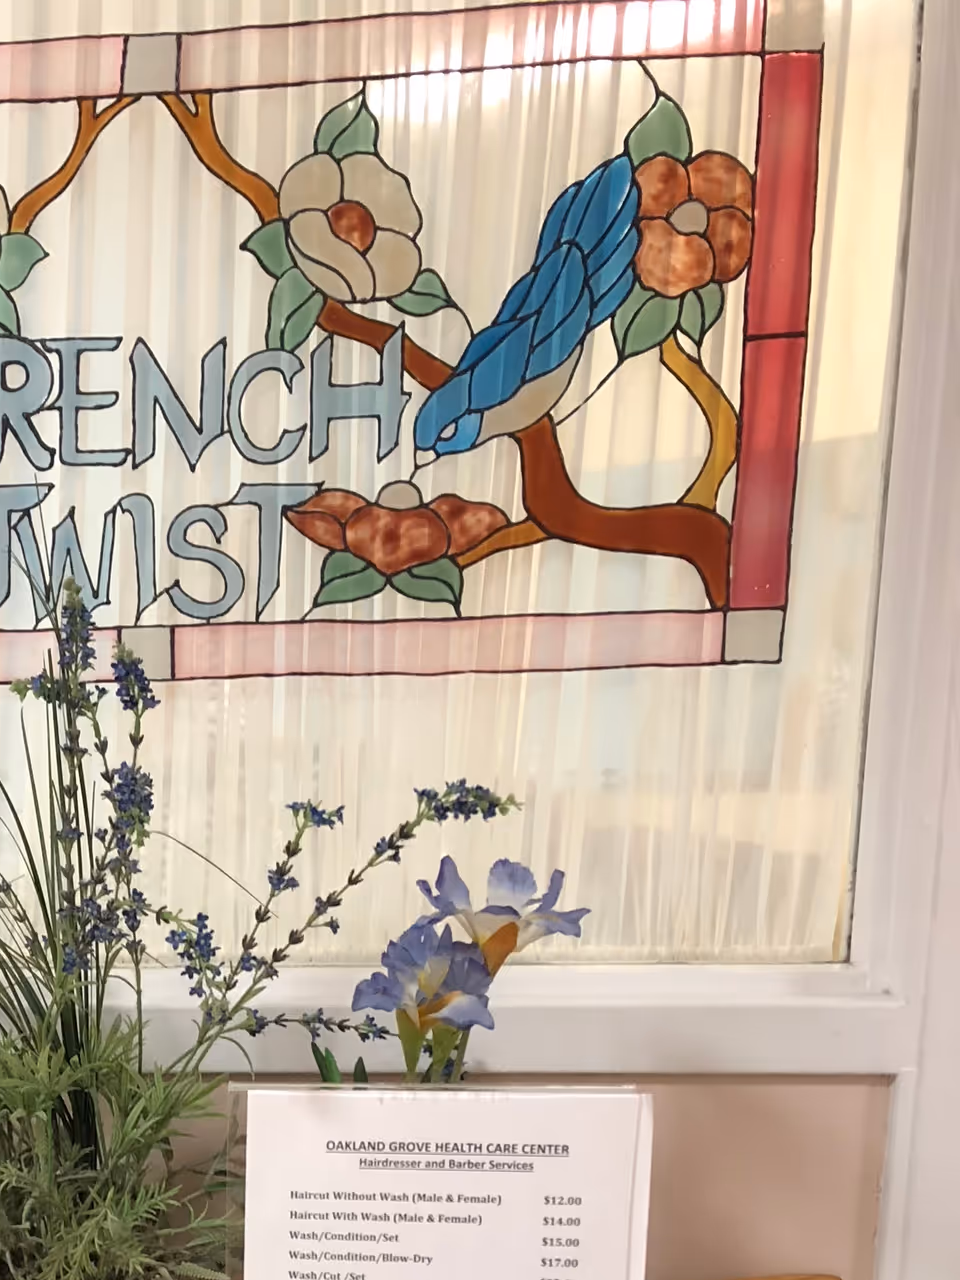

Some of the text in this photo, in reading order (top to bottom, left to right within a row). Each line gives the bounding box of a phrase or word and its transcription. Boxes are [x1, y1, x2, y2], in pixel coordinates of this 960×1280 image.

[326, 1140, 569, 1155] OAKLAND GROVE HEALTH CARE CENTER
[359, 1158, 534, 1171] Hairdresser and Barber Services
[290, 1191, 502, 1205] Haircut Without Wash (Male & Female)
[544, 1196, 582, 1206] $12.00
[290, 1211, 482, 1225] Haircut With Wash (Male & Female)
[543, 1217, 581, 1226] $14.00
[290, 1231, 398, 1243] Wash/Condition/Set
[542, 1238, 580, 1247] $15.00
[289, 1251, 433, 1265] Wash/Condition/Blow-Dry
[540, 1258, 578, 1268] $17.00
[288, 1271, 340, 1280] Wash/Cut
